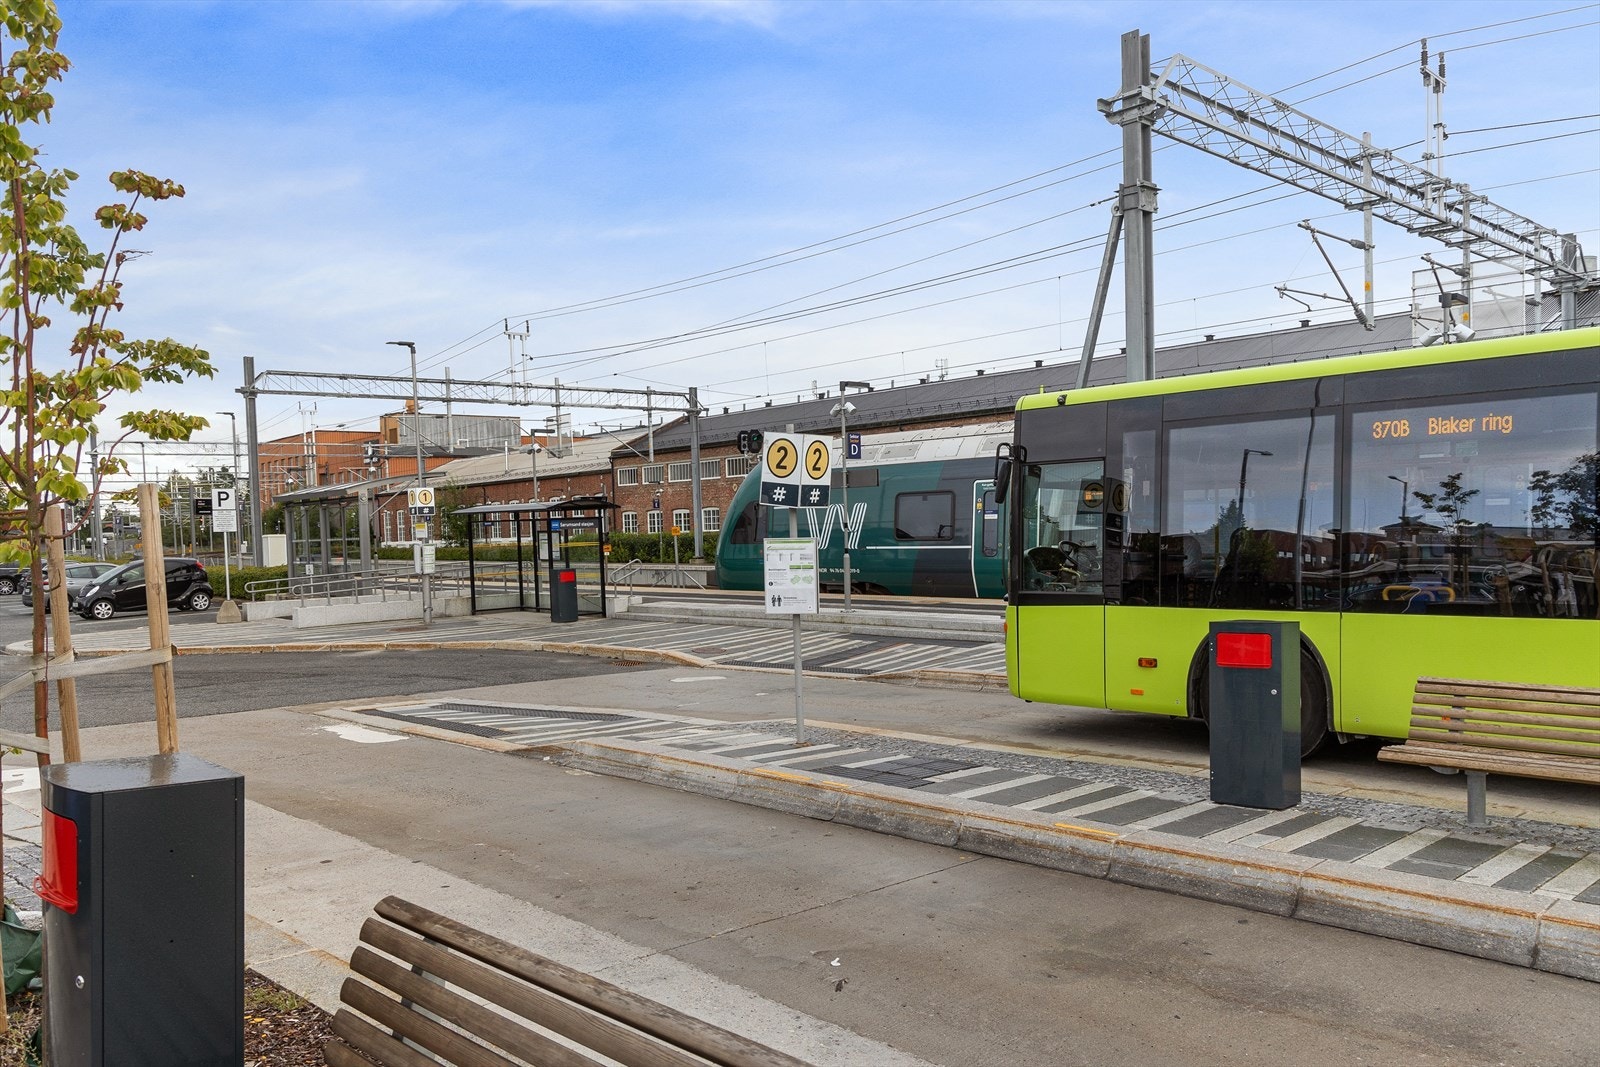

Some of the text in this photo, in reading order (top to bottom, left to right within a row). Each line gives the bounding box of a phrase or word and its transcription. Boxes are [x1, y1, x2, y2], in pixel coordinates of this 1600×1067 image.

[1372, 413, 1514, 439] 370B Blaker ring
[775, 446, 788, 470] 2
[851, 444, 859, 455] D
[812, 448, 821, 472] 2
[217, 491, 230, 507] P
[423, 493, 427, 502] 1
